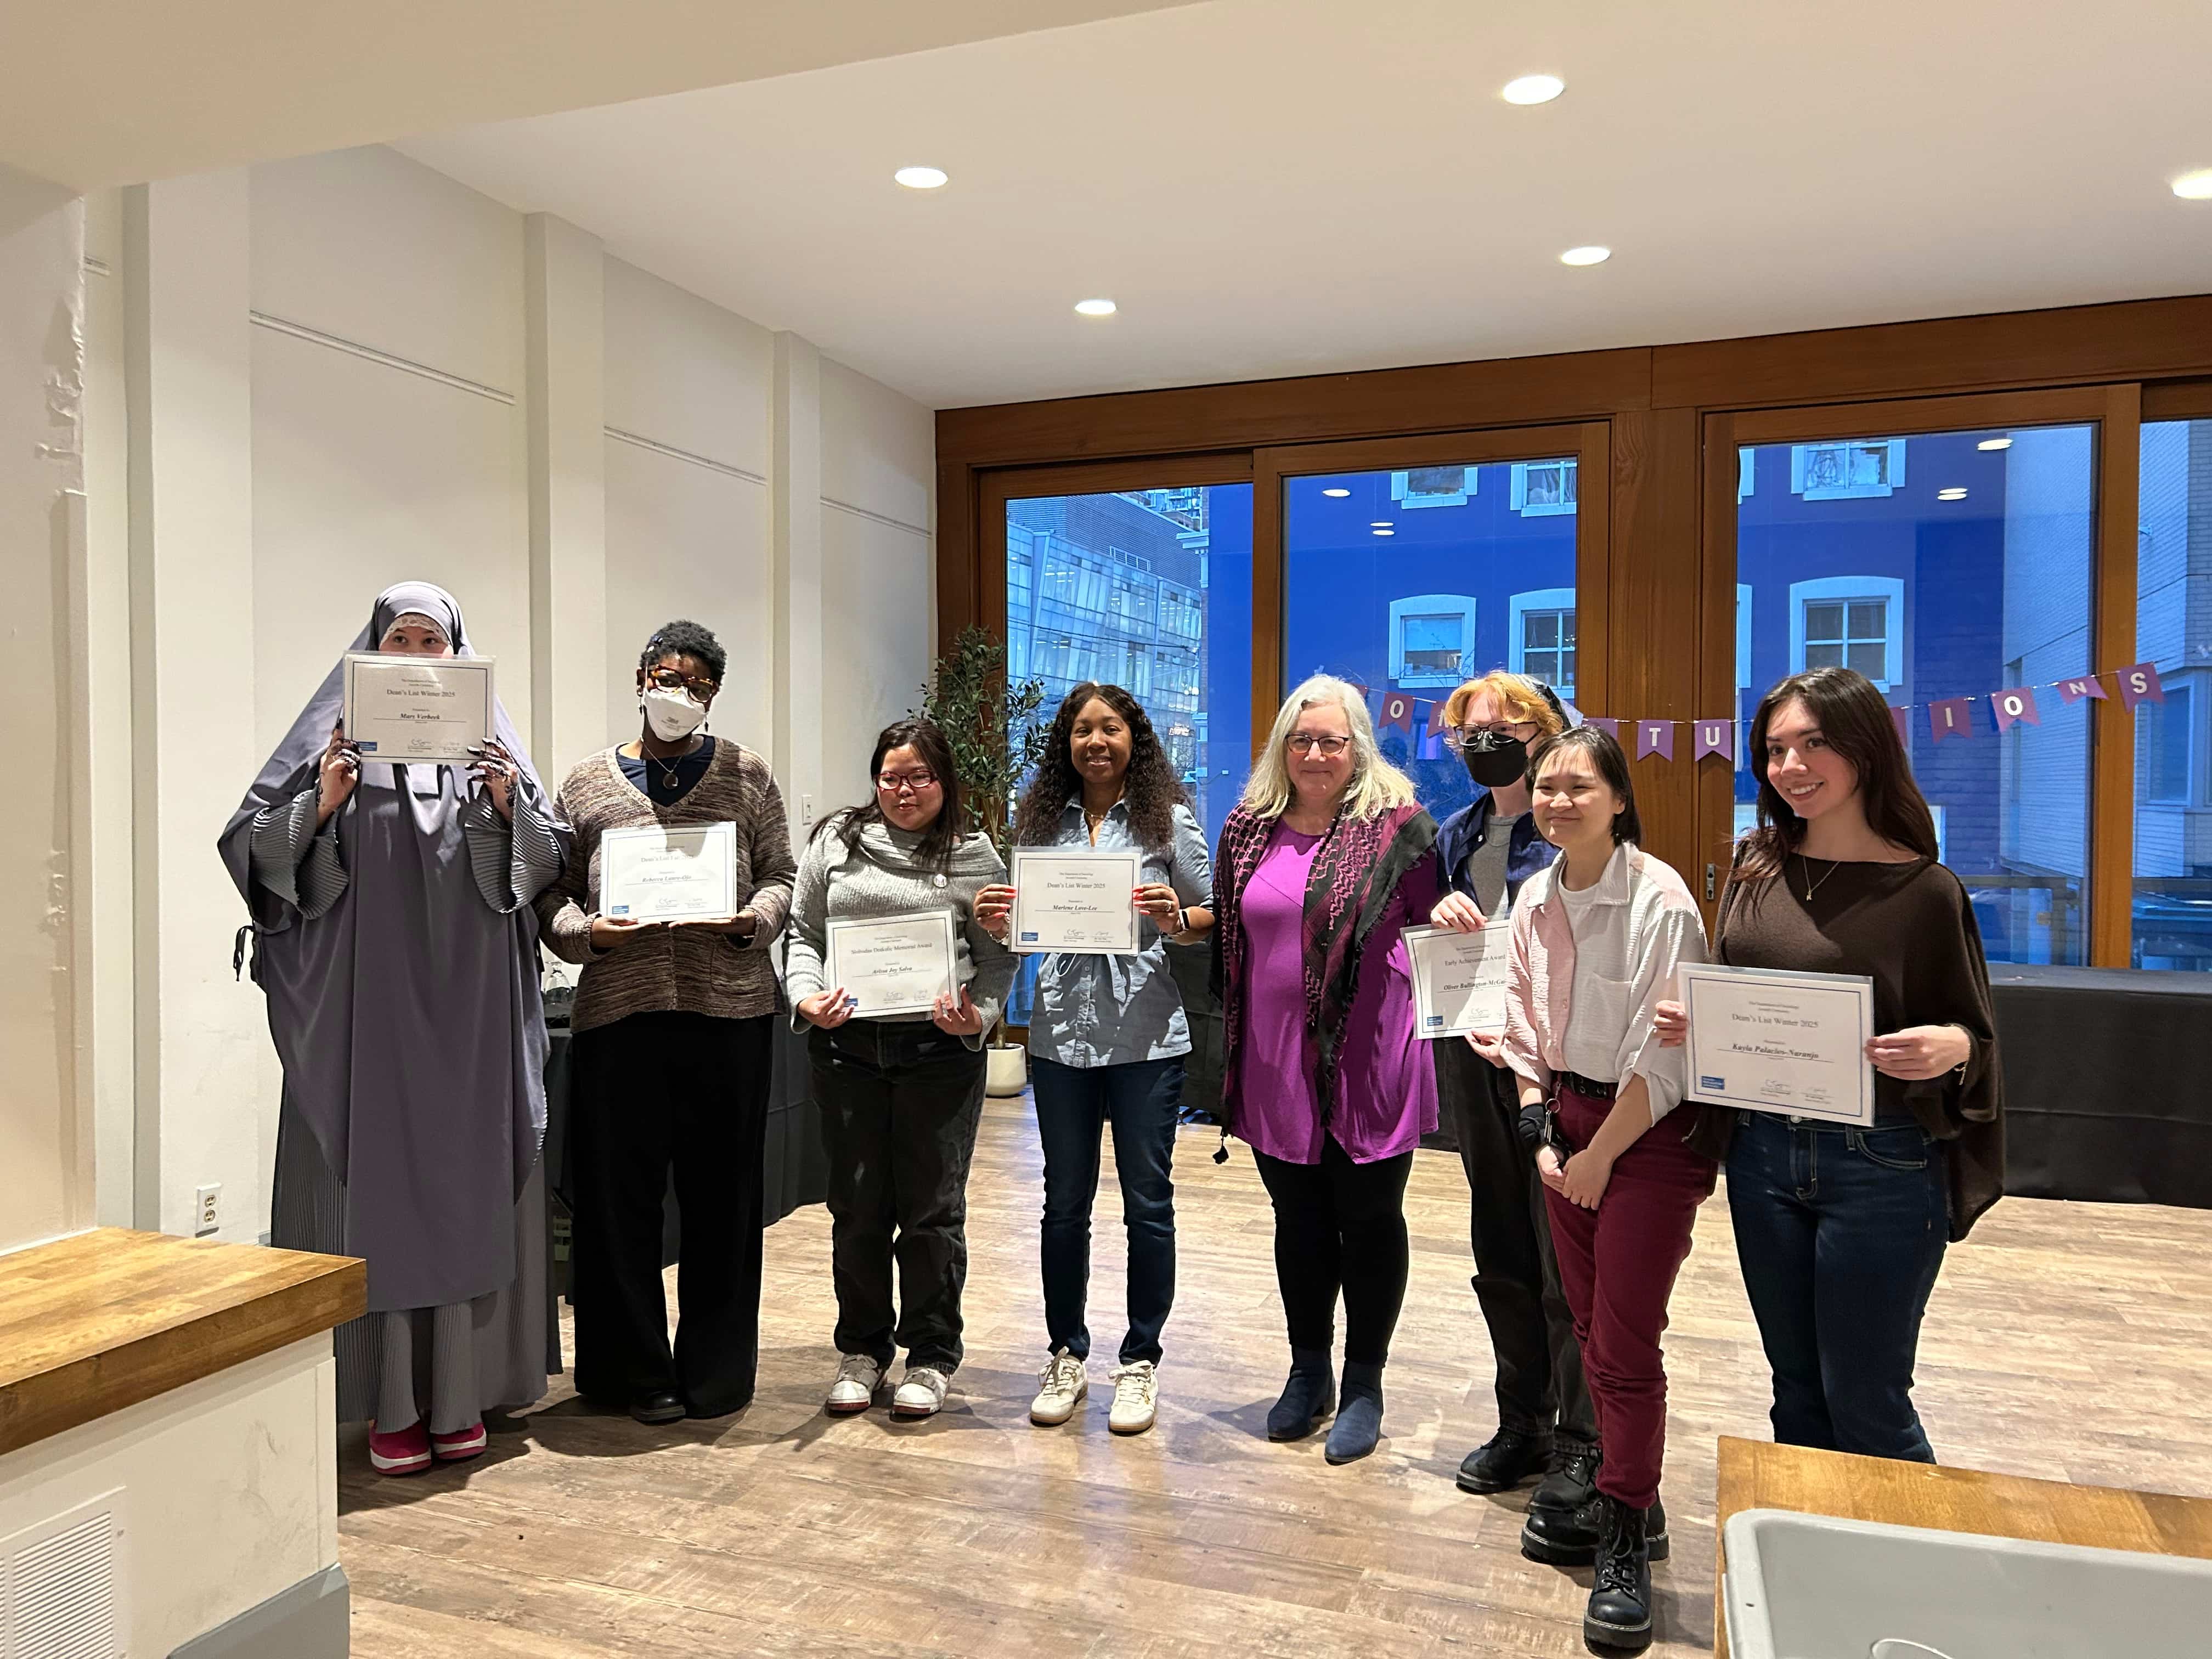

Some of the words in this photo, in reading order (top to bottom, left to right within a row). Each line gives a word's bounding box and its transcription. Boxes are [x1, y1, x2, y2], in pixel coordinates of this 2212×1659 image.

[1732, 1014, 1756, 1022] Dean's
[1773, 1018, 1799, 1026] Winter
[1800, 1020, 1819, 1028] 2025
[1733, 1043, 1753, 1053] Kayla
